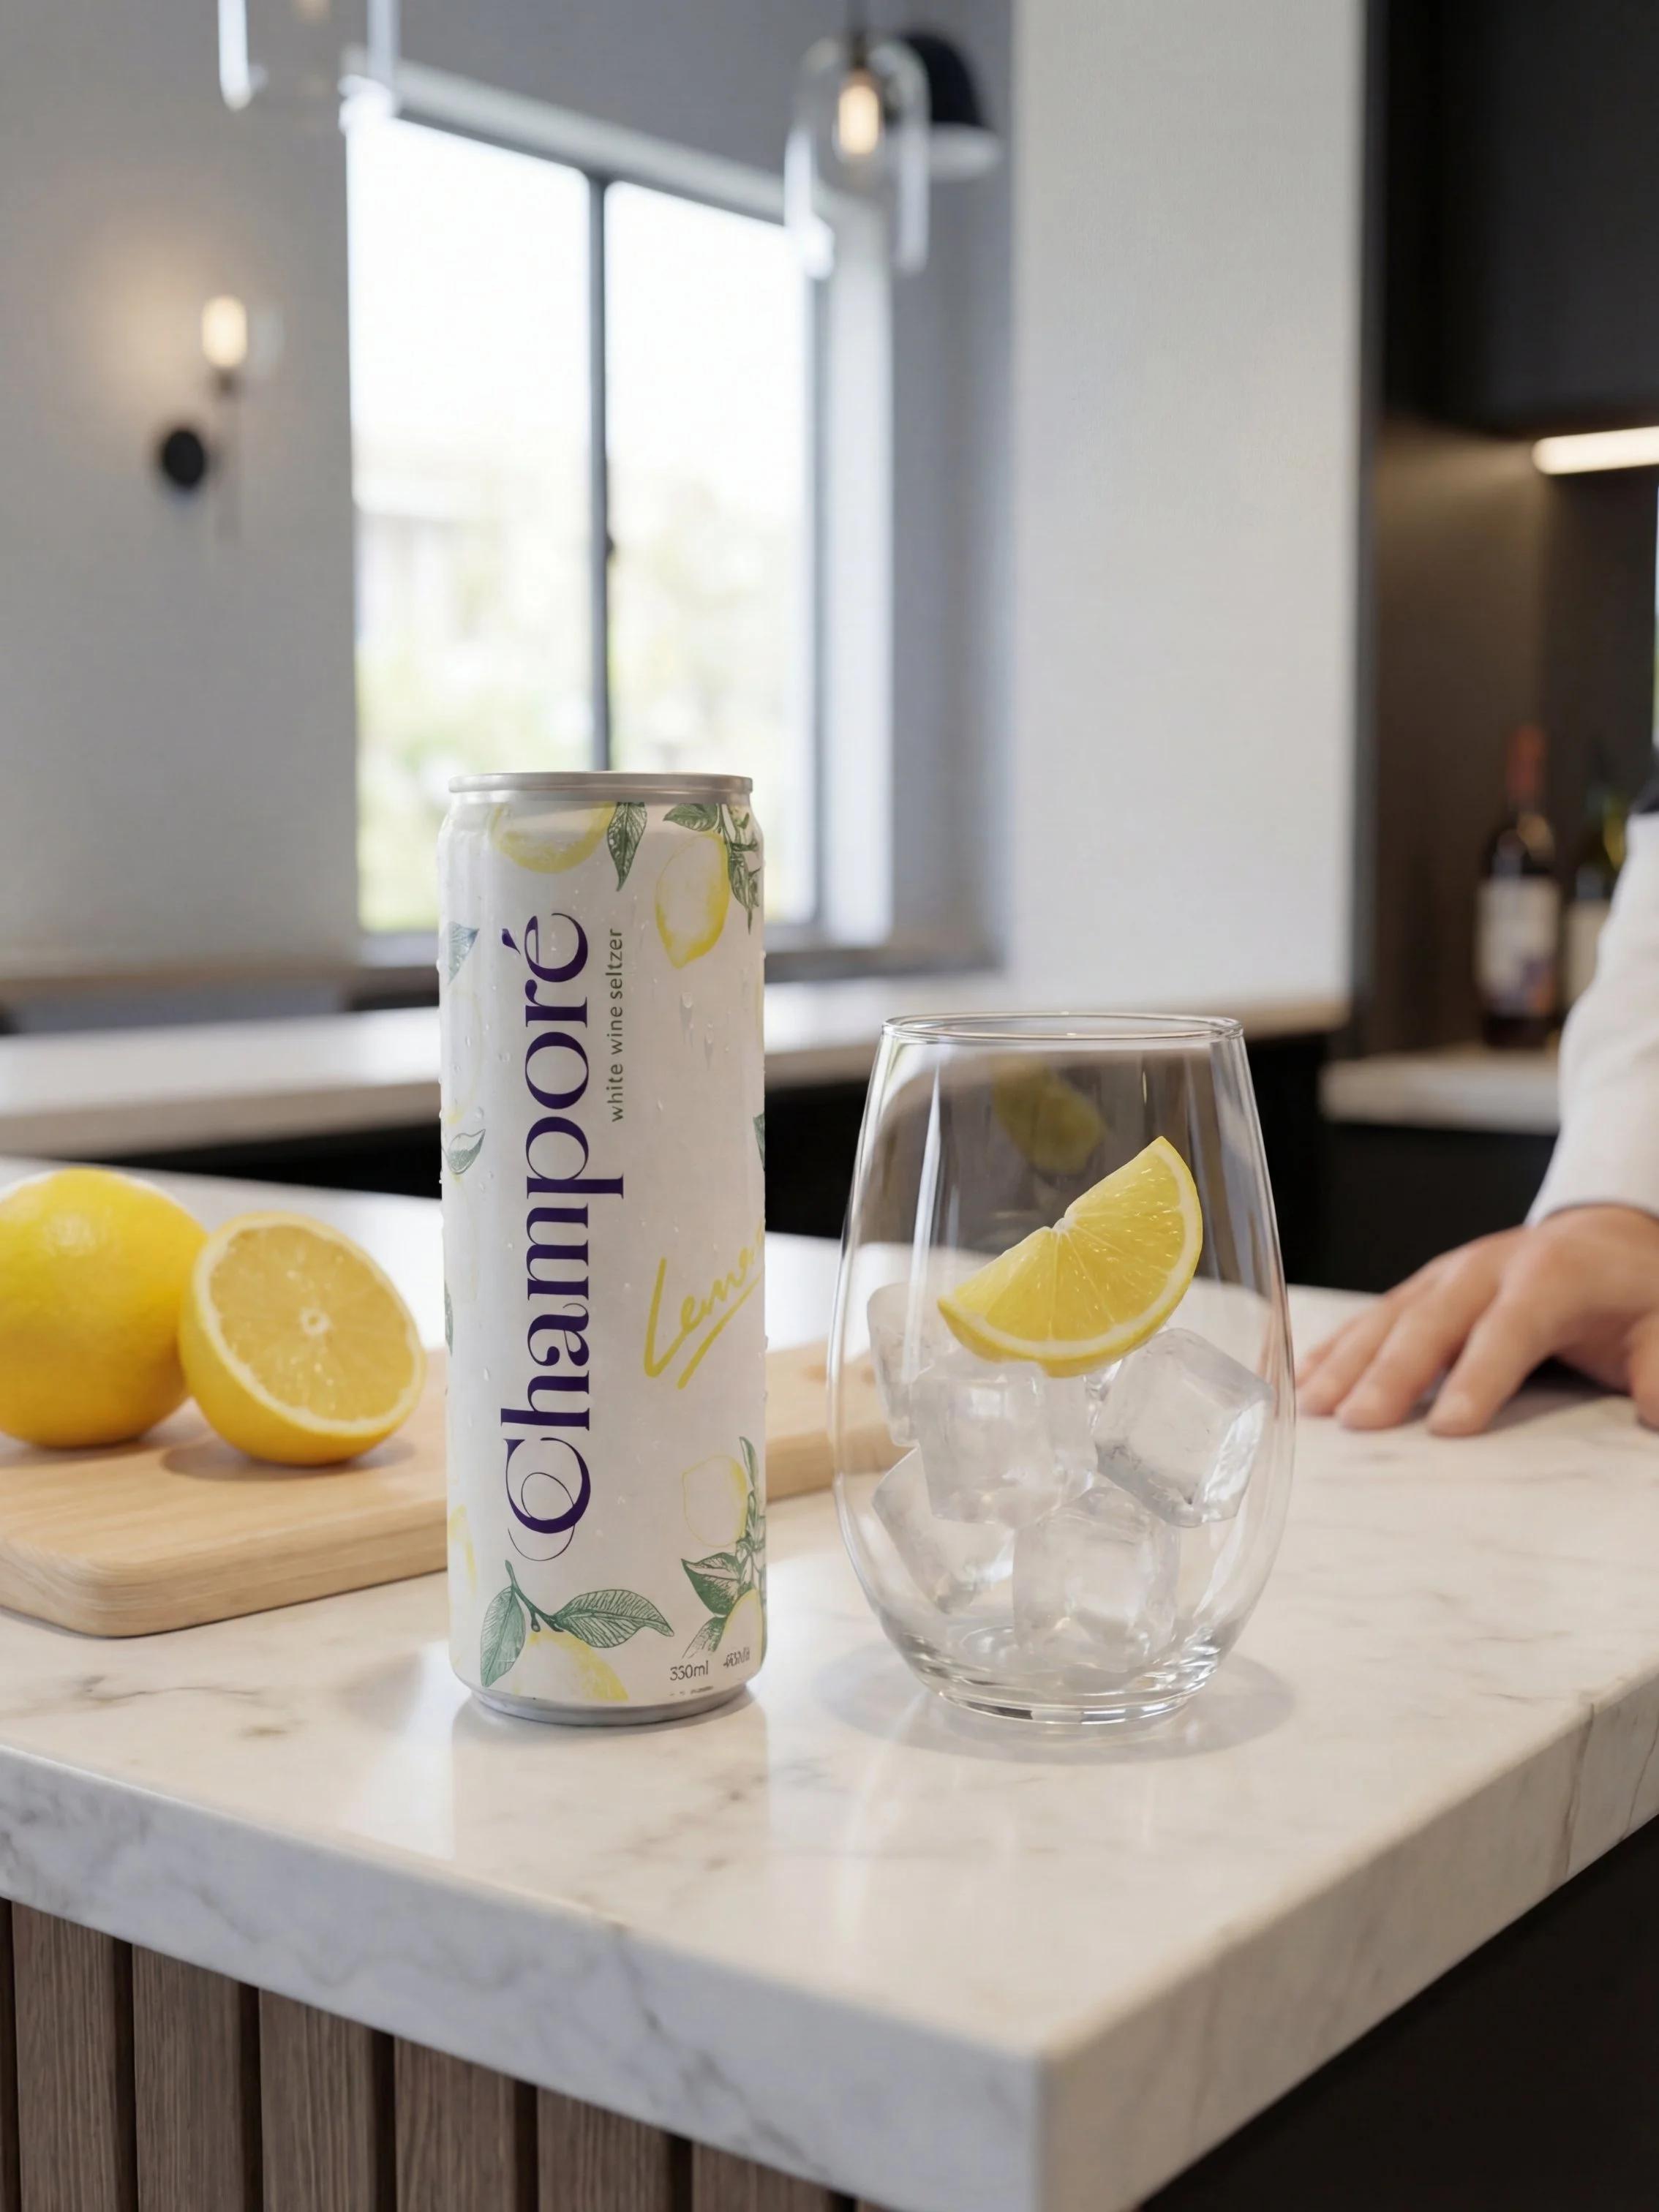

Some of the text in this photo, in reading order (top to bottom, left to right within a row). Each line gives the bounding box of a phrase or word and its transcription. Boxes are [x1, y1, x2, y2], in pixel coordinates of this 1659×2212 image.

[500, 912, 624, 1561] Champoré
[605, 928, 624, 1123] white wine seltzer
